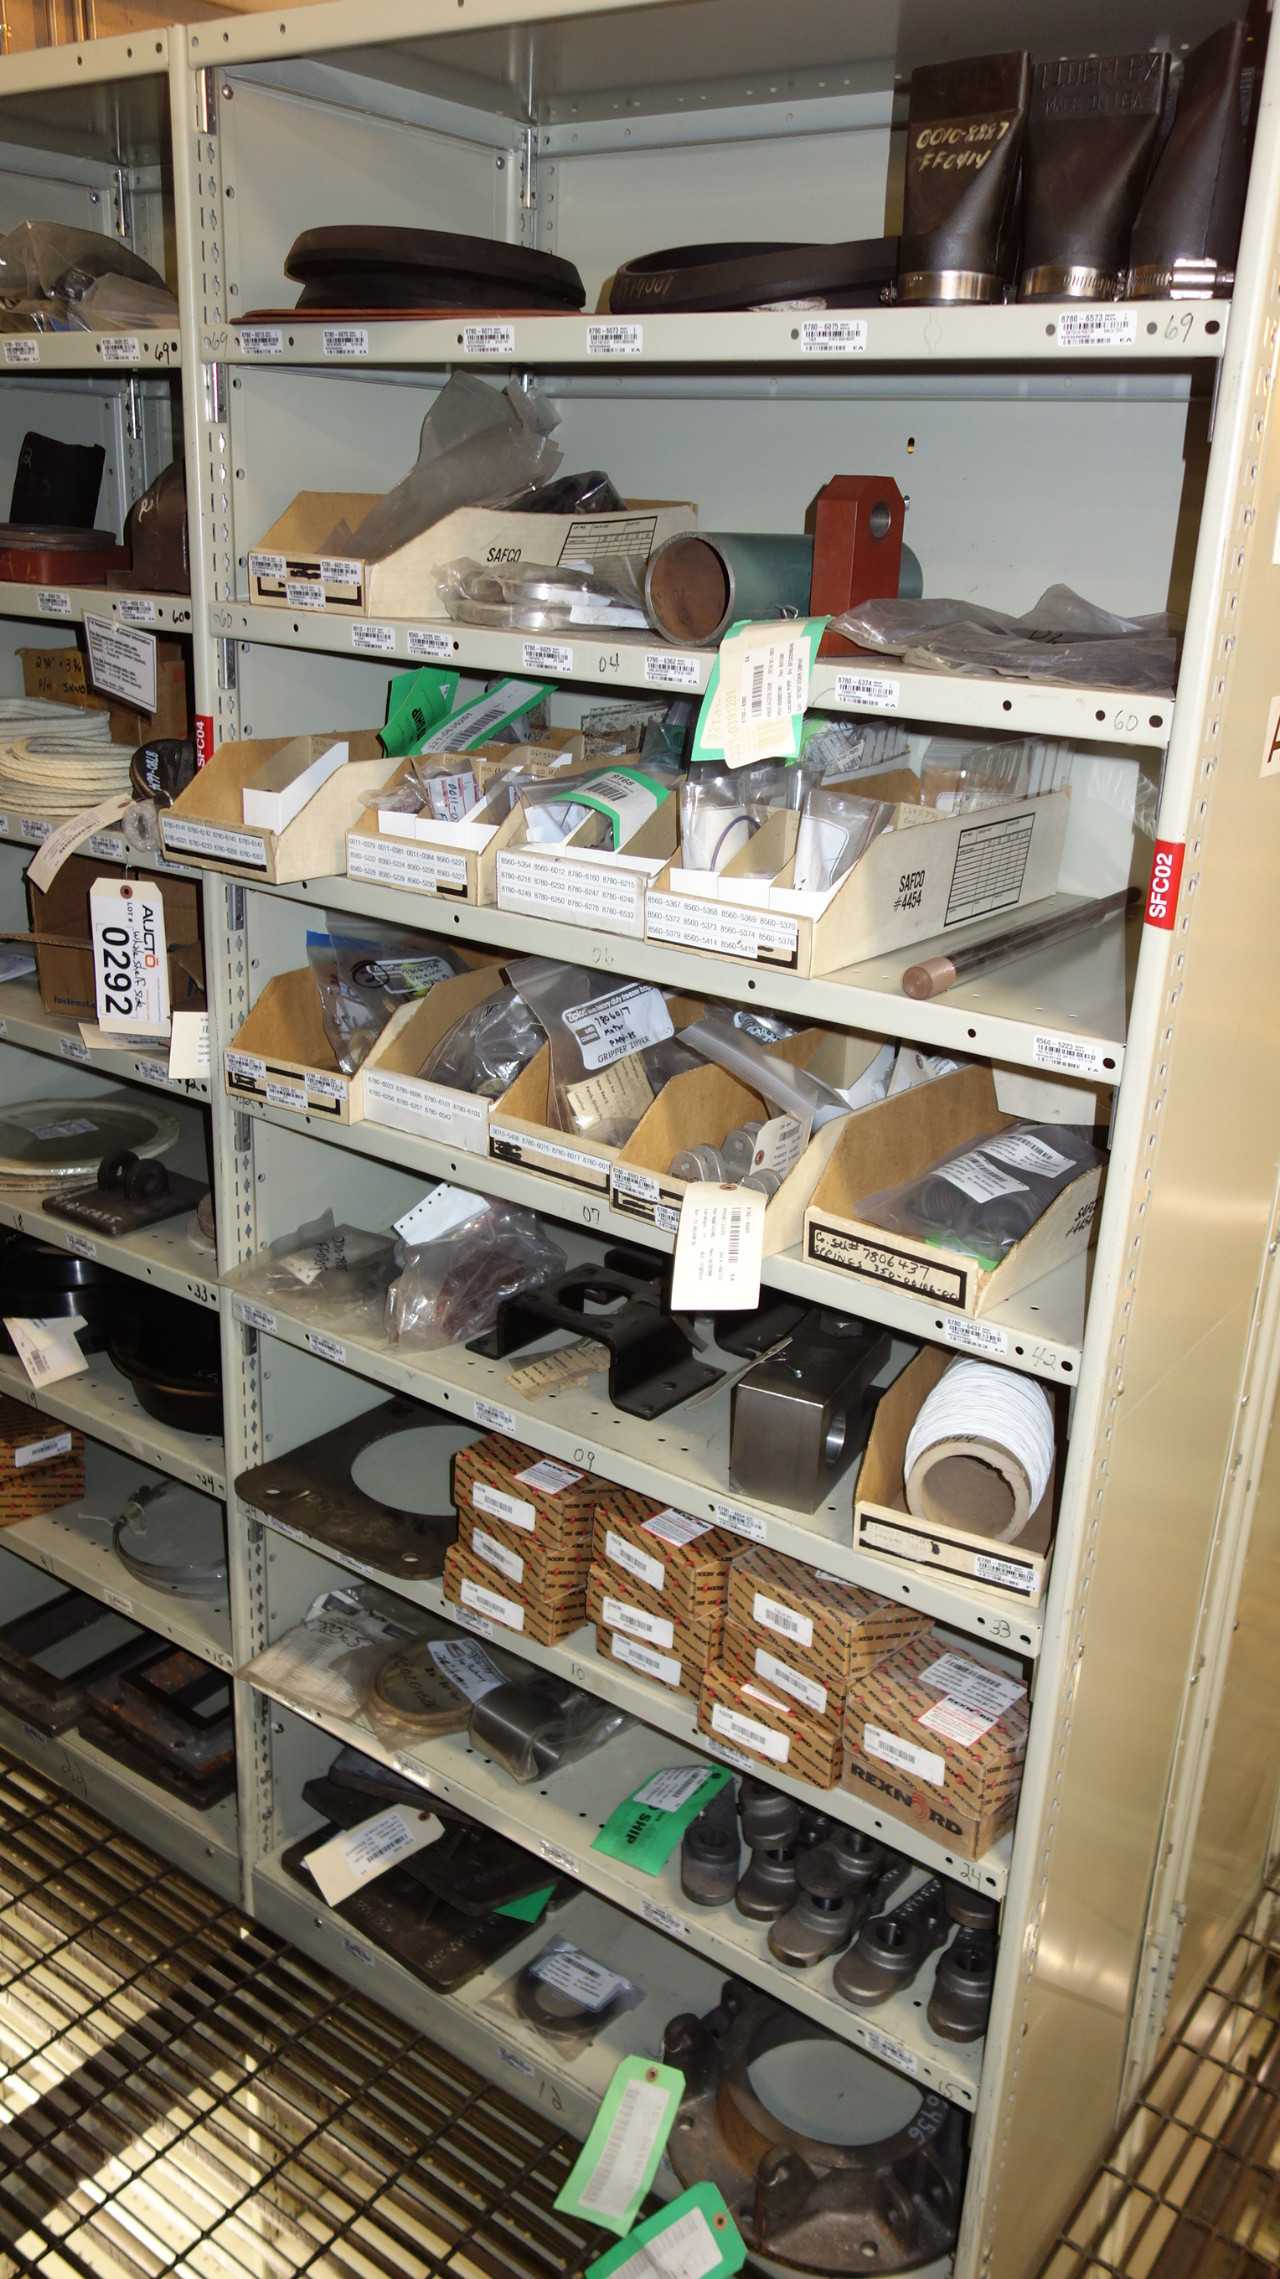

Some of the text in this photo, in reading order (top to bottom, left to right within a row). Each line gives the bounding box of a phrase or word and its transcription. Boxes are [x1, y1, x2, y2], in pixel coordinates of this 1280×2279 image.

[1164, 312, 1194, 344] 69
[487, 547, 522, 564] SAFCO
[1113, 710, 1138, 731] 60
[196, 721, 206, 768] SFC04
[899, 870, 926, 893] SAFCO
[1148, 852, 1173, 919] SFC02
[893, 890, 922, 912] #4454
[101, 926, 133, 1016] 0292
[597, 1043, 628, 1063] GRIPPER
[582, 1206, 600, 1224] 07
[862, 1247, 930, 1279] 7806437
[194, 1284, 208, 1302] 33
[573, 1448, 596, 1471] 09
[988, 1619, 1011, 1639] 33
[850, 1762, 964, 1837] REXNORD
[625, 1812, 652, 1844] SHIP
